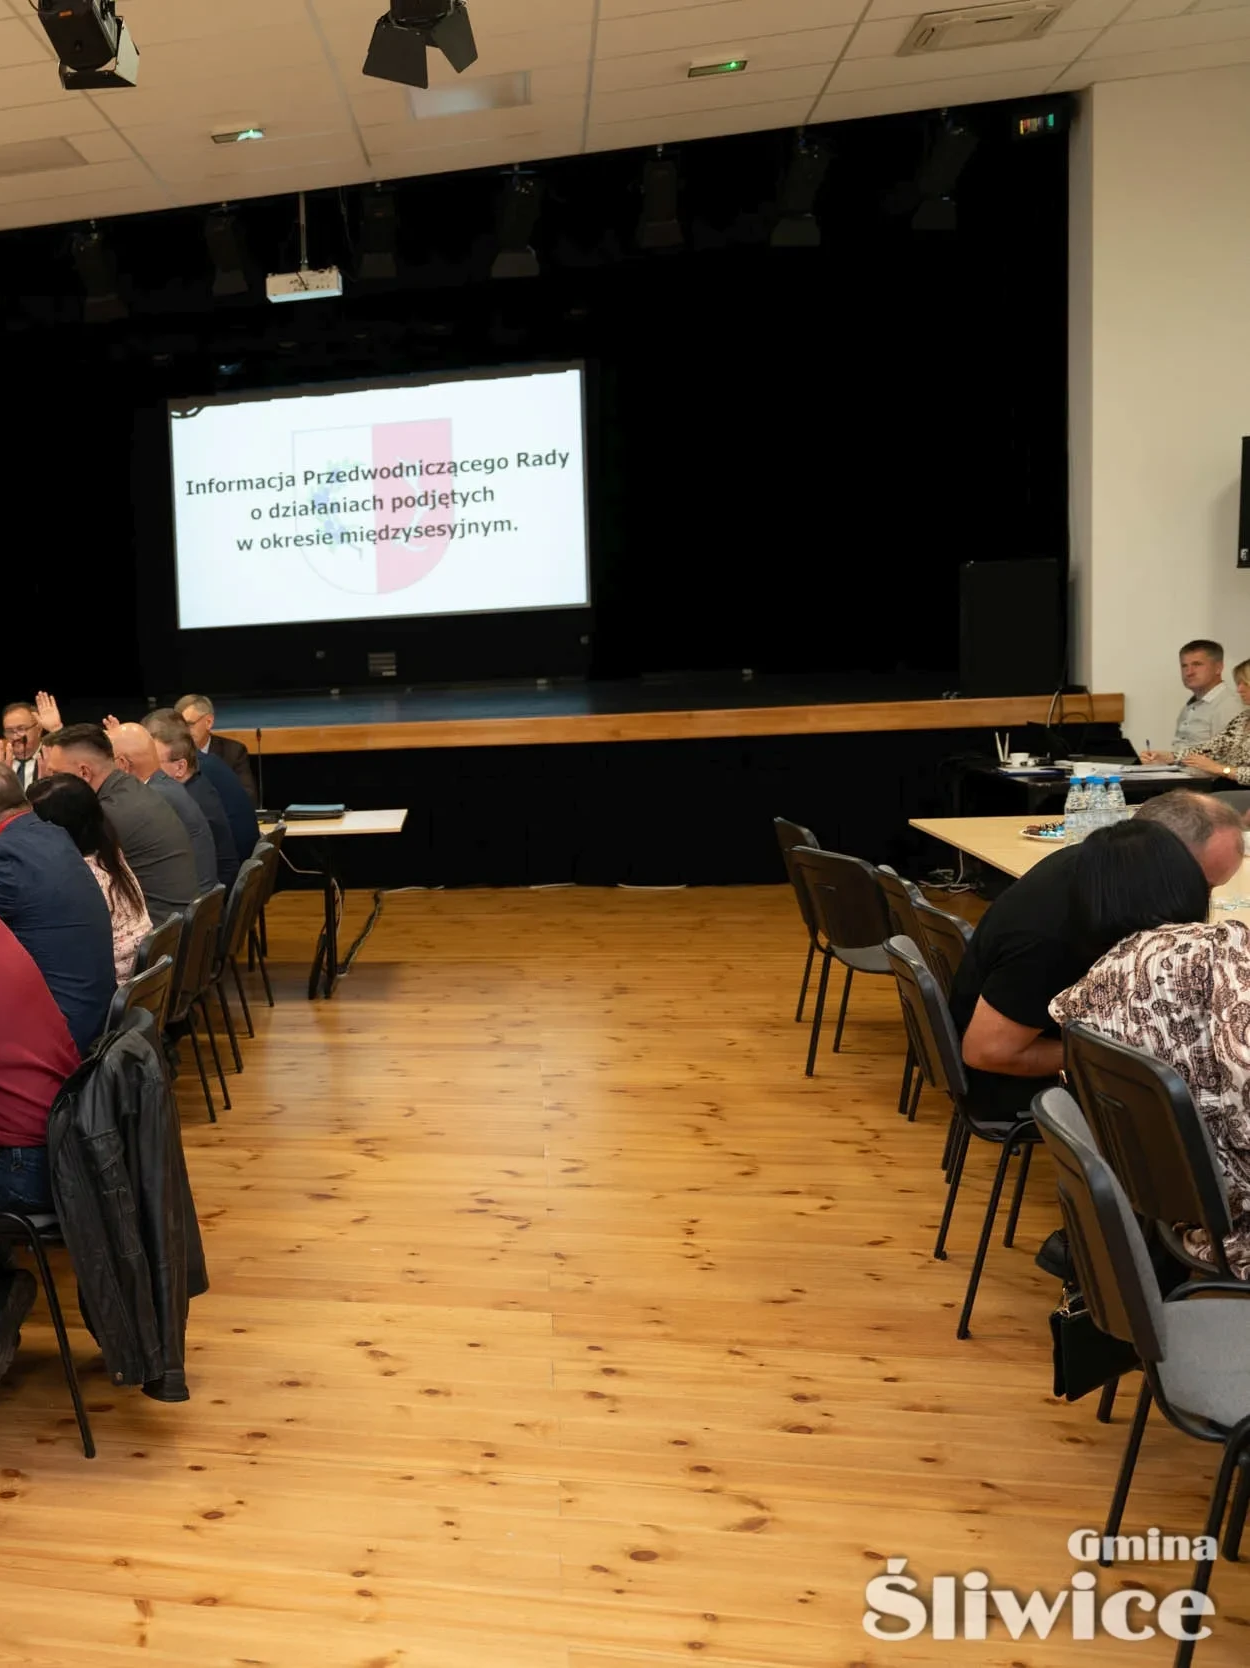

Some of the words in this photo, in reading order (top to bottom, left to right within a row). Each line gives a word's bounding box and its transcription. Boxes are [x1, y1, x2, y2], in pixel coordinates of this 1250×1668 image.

[185, 469, 296, 496] Informacja
[303, 455, 509, 487] Przedwodniczącego
[516, 448, 570, 473] Rady
[250, 506, 262, 521] o
[268, 494, 384, 519] działaniach
[391, 486, 495, 513] podjętych
[236, 537, 254, 552] w
[260, 528, 334, 549] okresie
[339, 518, 519, 545] międzysesyjnym.
